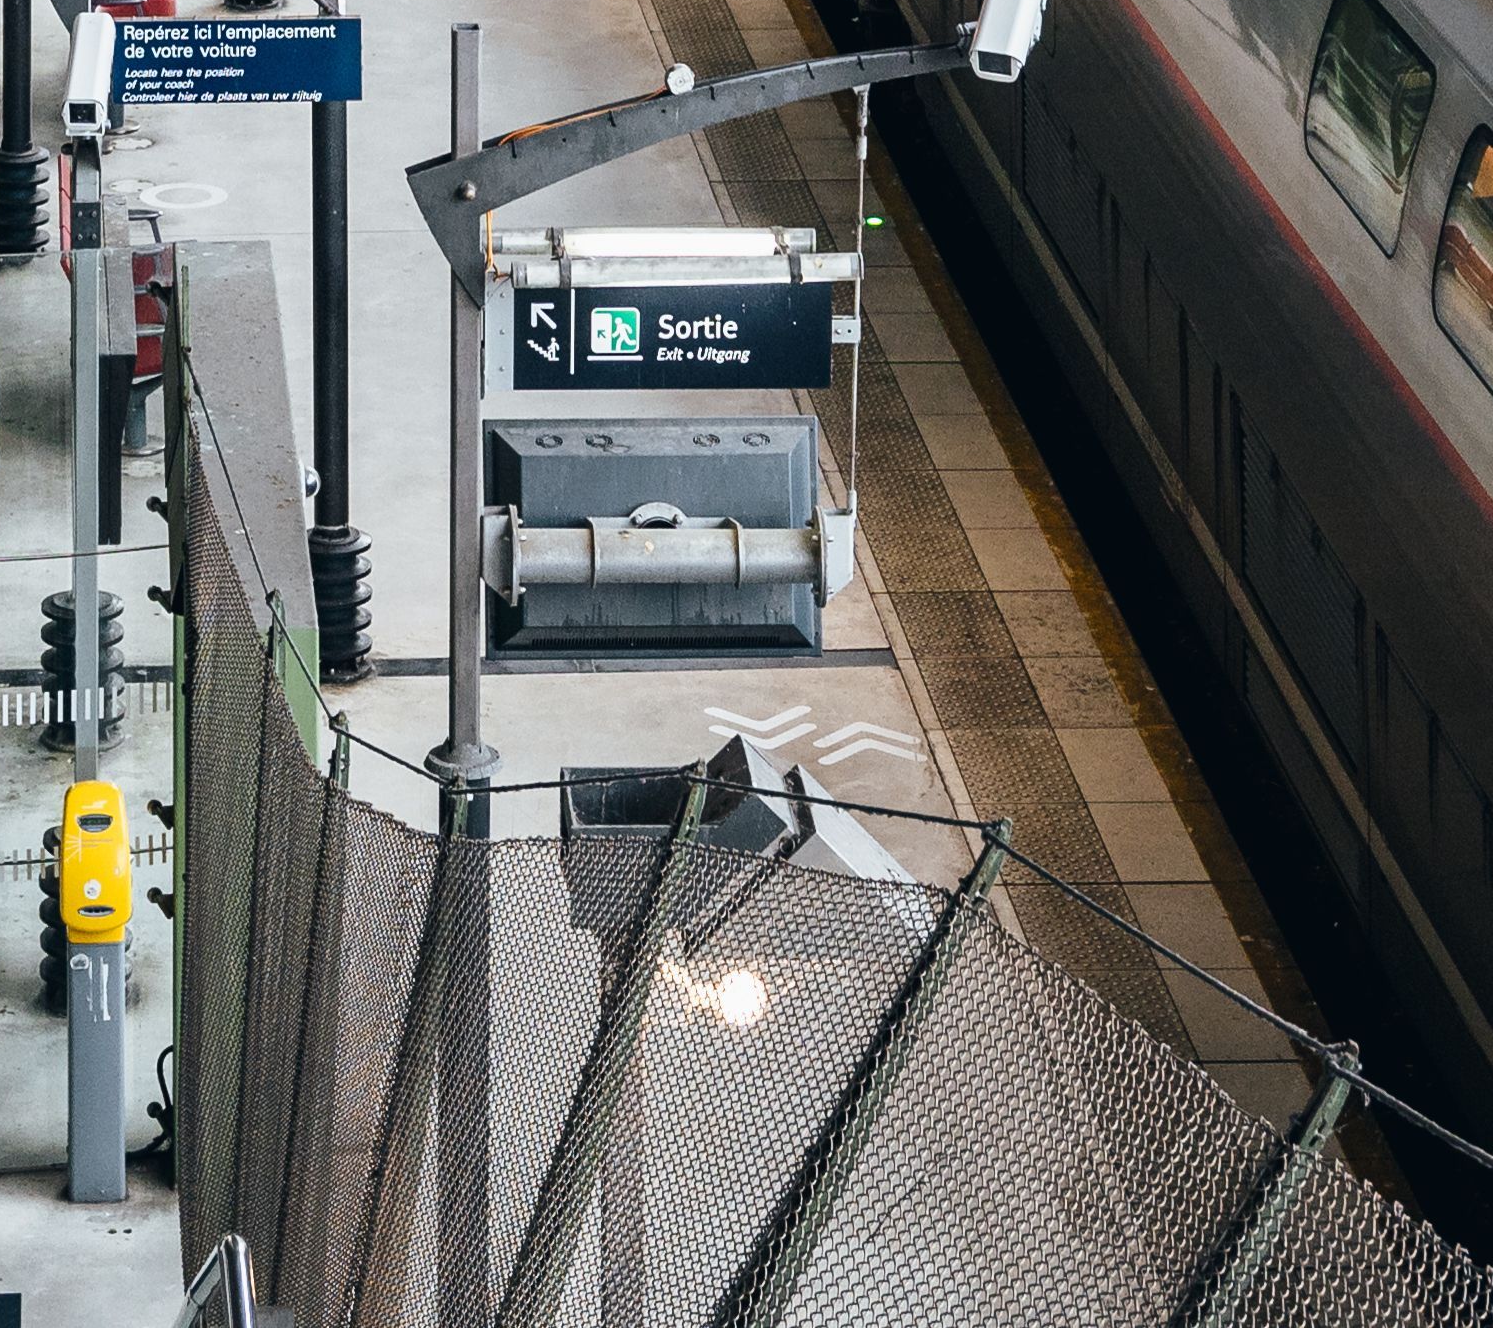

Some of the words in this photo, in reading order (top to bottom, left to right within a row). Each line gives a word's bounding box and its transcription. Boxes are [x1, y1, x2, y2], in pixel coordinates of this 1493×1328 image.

[123, 25, 189, 43] Repérez
[194, 25, 212, 40] ici
[217, 24, 336, 42] l'emplacement
[124, 44, 145, 59] de
[151, 45, 194, 59] votre
[200, 43, 256, 58] voiture
[125, 68, 158, 78] Locate
[161, 68, 183, 78] here
[186, 68, 202, 78] the
[205, 67, 245, 79] position
[125, 80, 136, 90] of
[139, 81, 162, 92] your
[164, 79, 194, 89] coach
[122, 92, 175, 103] Controleer
[177, 91, 198, 102] hier
[200, 91, 214, 102] de
[217, 91, 248, 103] plaats
[251, 92, 269, 102] van
[272, 92, 289, 101] uw
[291, 90, 323, 103] rijtuig
[658, 313, 738, 339] Sortie
[656, 347, 683, 361] Exit
[696, 347, 751, 364] Uitgang
